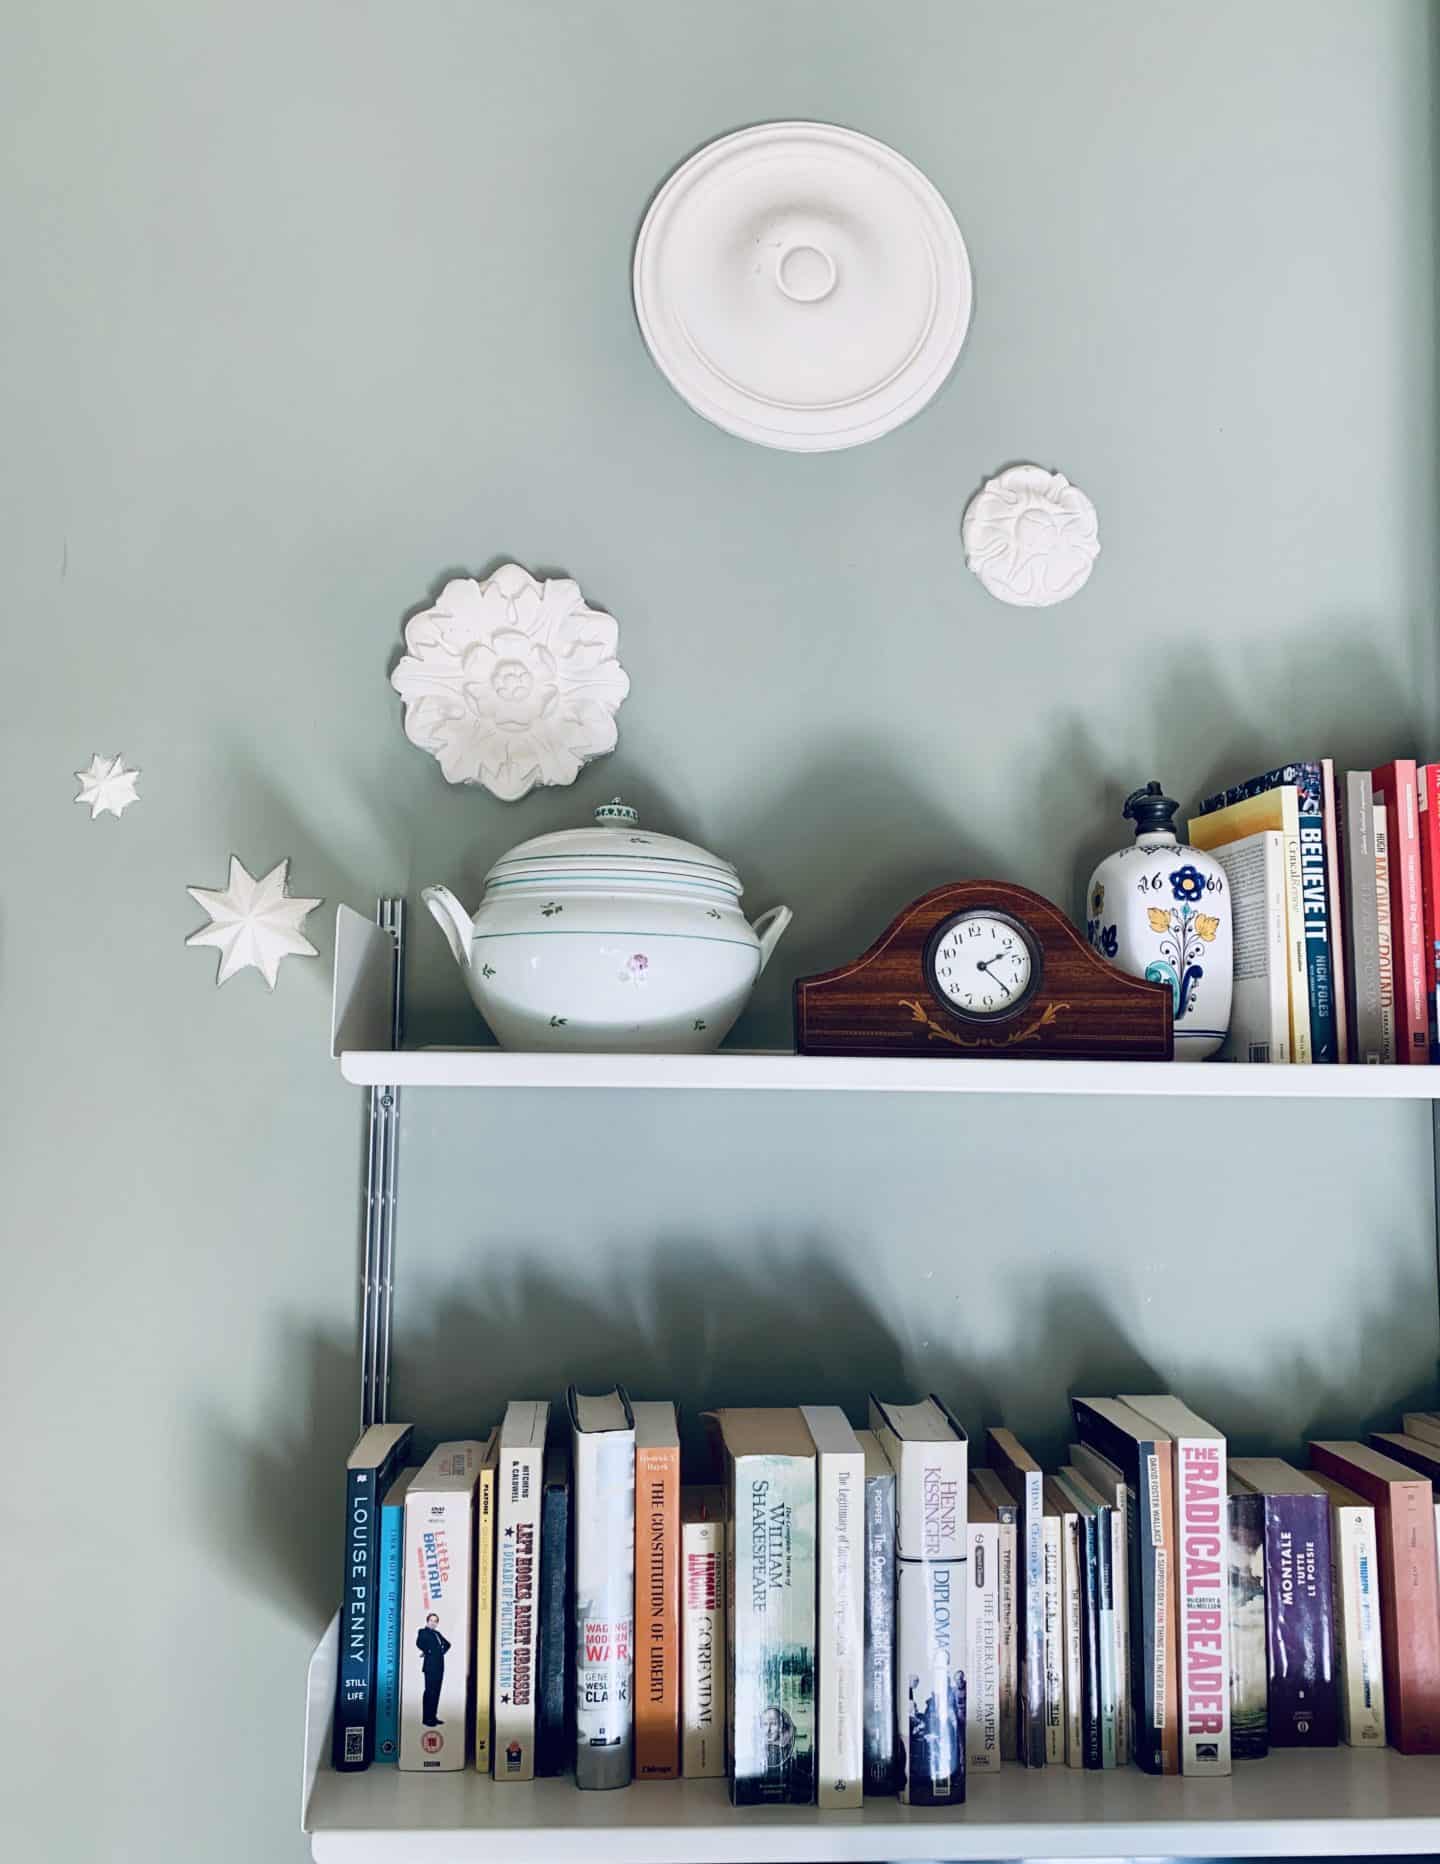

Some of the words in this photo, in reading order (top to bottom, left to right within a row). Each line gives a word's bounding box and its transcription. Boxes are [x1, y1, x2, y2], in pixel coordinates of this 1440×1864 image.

[1375, 832, 1386, 853] HUGH
[1300, 827, 1326, 914] BELIEVE
[1375, 856, 1389, 881] MY
[1376, 884, 1391, 930] OWN
[953, 933, 963, 945] 11
[968, 926, 982, 937] 12
[990, 927, 996, 939] 1
[1002, 939, 1013, 950] 2
[1304, 920, 1327, 942] IT
[943, 948, 957, 960] 10
[1011, 954, 1022, 966] 3
[1315, 955, 1328, 982] NICK
[941, 967, 952, 977] 9
[949, 983, 960, 994] 8
[964, 993, 975, 1005] 7
[982, 996, 994, 1007] 6
[1317, 984, 1329, 1017] FOLES
[1149, 1457, 1158, 1480] DAVID
[1181, 1447, 1218, 1460] THE
[511, 1469, 520, 1503] CALDWELL
[521, 1464, 530, 1499] HITCHENS
[651, 1480, 665, 1508] THE
[838, 1471, 851, 1486] The
[1150, 1481, 1160, 1509] FOSTER
[482, 1482, 490, 1515] PLATONE
[874, 1489, 882, 1525] POPPER
[923, 1467, 941, 1554] KISSINGER
[940, 1480, 957, 1542] HENRY
[1030, 1480, 1040, 1512] VIDAL
[351, 1496, 368, 1578] LOUISE
[515, 1523, 533, 1555] LEFT
[873, 1534, 885, 1553] The
[1151, 1510, 1162, 1545] WALLACE
[1184, 1461, 1220, 1595] RADICAL
[434, 1529, 451, 1583] Little
[752, 1480, 769, 1614] SHAKESPEARE
[768, 1503, 785, 1590] WILLIAM
[1306, 1541, 1315, 1581] POESIE
[423, 1532, 442, 1599] BRITAIN
[502, 1553, 513, 1586] DECADE
[512, 1558, 533, 1604] HOOKS,
[650, 1512, 665, 1618] CONSTITUTION
[688, 1552, 715, 1610] LINCOLN
[871, 1556, 885, 1584] Open
[1280, 1531, 1294, 1605] MONTALE
[1296, 1553, 1306, 1585] TUTTE
[1359, 1556, 1369, 1595] TRIUMPH
[502, 1587, 513, 1599] OF
[1156, 1558, 1165, 1606] SUPPOSEDLY
[1307, 1584, 1316, 1597] LE
[983, 1592, 995, 1617] THE
[1156, 1607, 1164, 1624] FUN
[350, 1585, 366, 1663] PENNY
[501, 1601, 513, 1647] POLITICAL
[513, 1605, 532, 1646] RIGHT
[650, 1623, 665, 1641] OF
[1156, 1625, 1164, 1648] THING
[696, 1616, 713, 1668] GORE
[500, 1649, 511, 1688] WRITING
[650, 1646, 665, 1704] LIBERTY
[983, 1620, 996, 1698] FEDERALIST
[1187, 1610, 1223, 1735] READER
[345, 1679, 367, 1687] STILL
[512, 1647, 530, 1705] CROSSES
[873, 1671, 884, 1712] Enemies
[1156, 1664, 1164, 1688] NEVER
[347, 1692, 365, 1700] LIFE
[696, 1669, 713, 1730] VIDAL
[1156, 1689, 1164, 1700] DO
[984, 1703, 996, 1751] PAPERS
[1156, 1701, 1164, 1726] AGAIN
